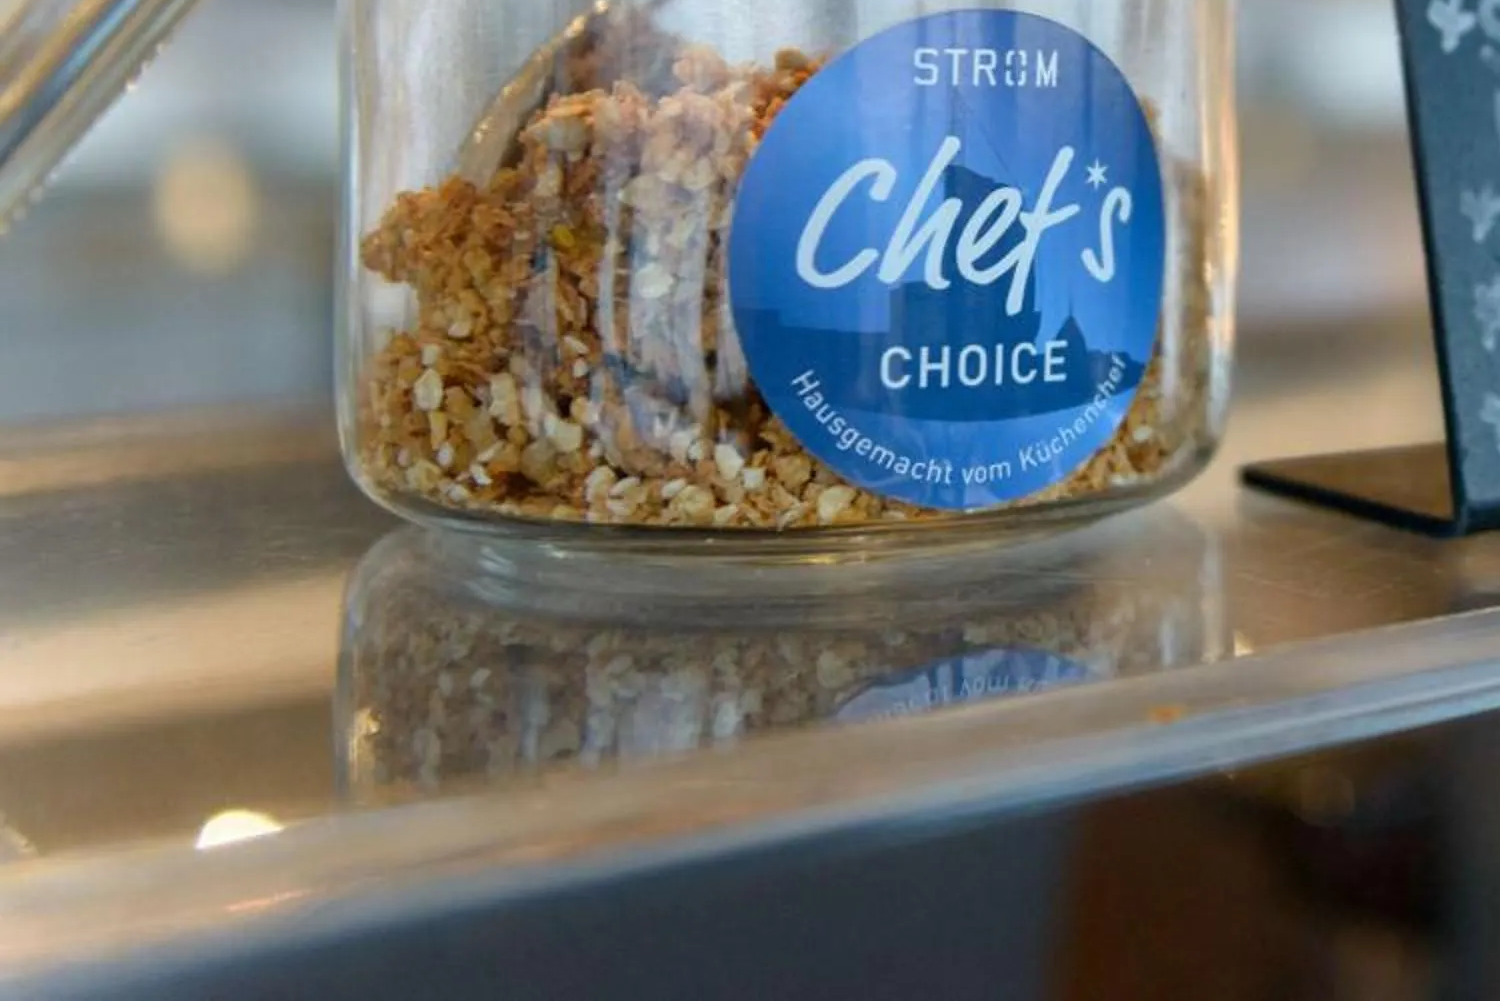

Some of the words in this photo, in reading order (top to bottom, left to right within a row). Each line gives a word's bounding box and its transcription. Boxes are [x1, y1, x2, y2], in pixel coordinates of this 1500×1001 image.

[912, 47, 1060, 88] STROM
[796, 135, 1132, 317] Chef's
[880, 339, 1069, 390] CHOICE
[791, 368, 953, 486] Hausgemacht
[961, 458, 1012, 485] vom
[1018, 352, 1128, 472] Küchenchef
